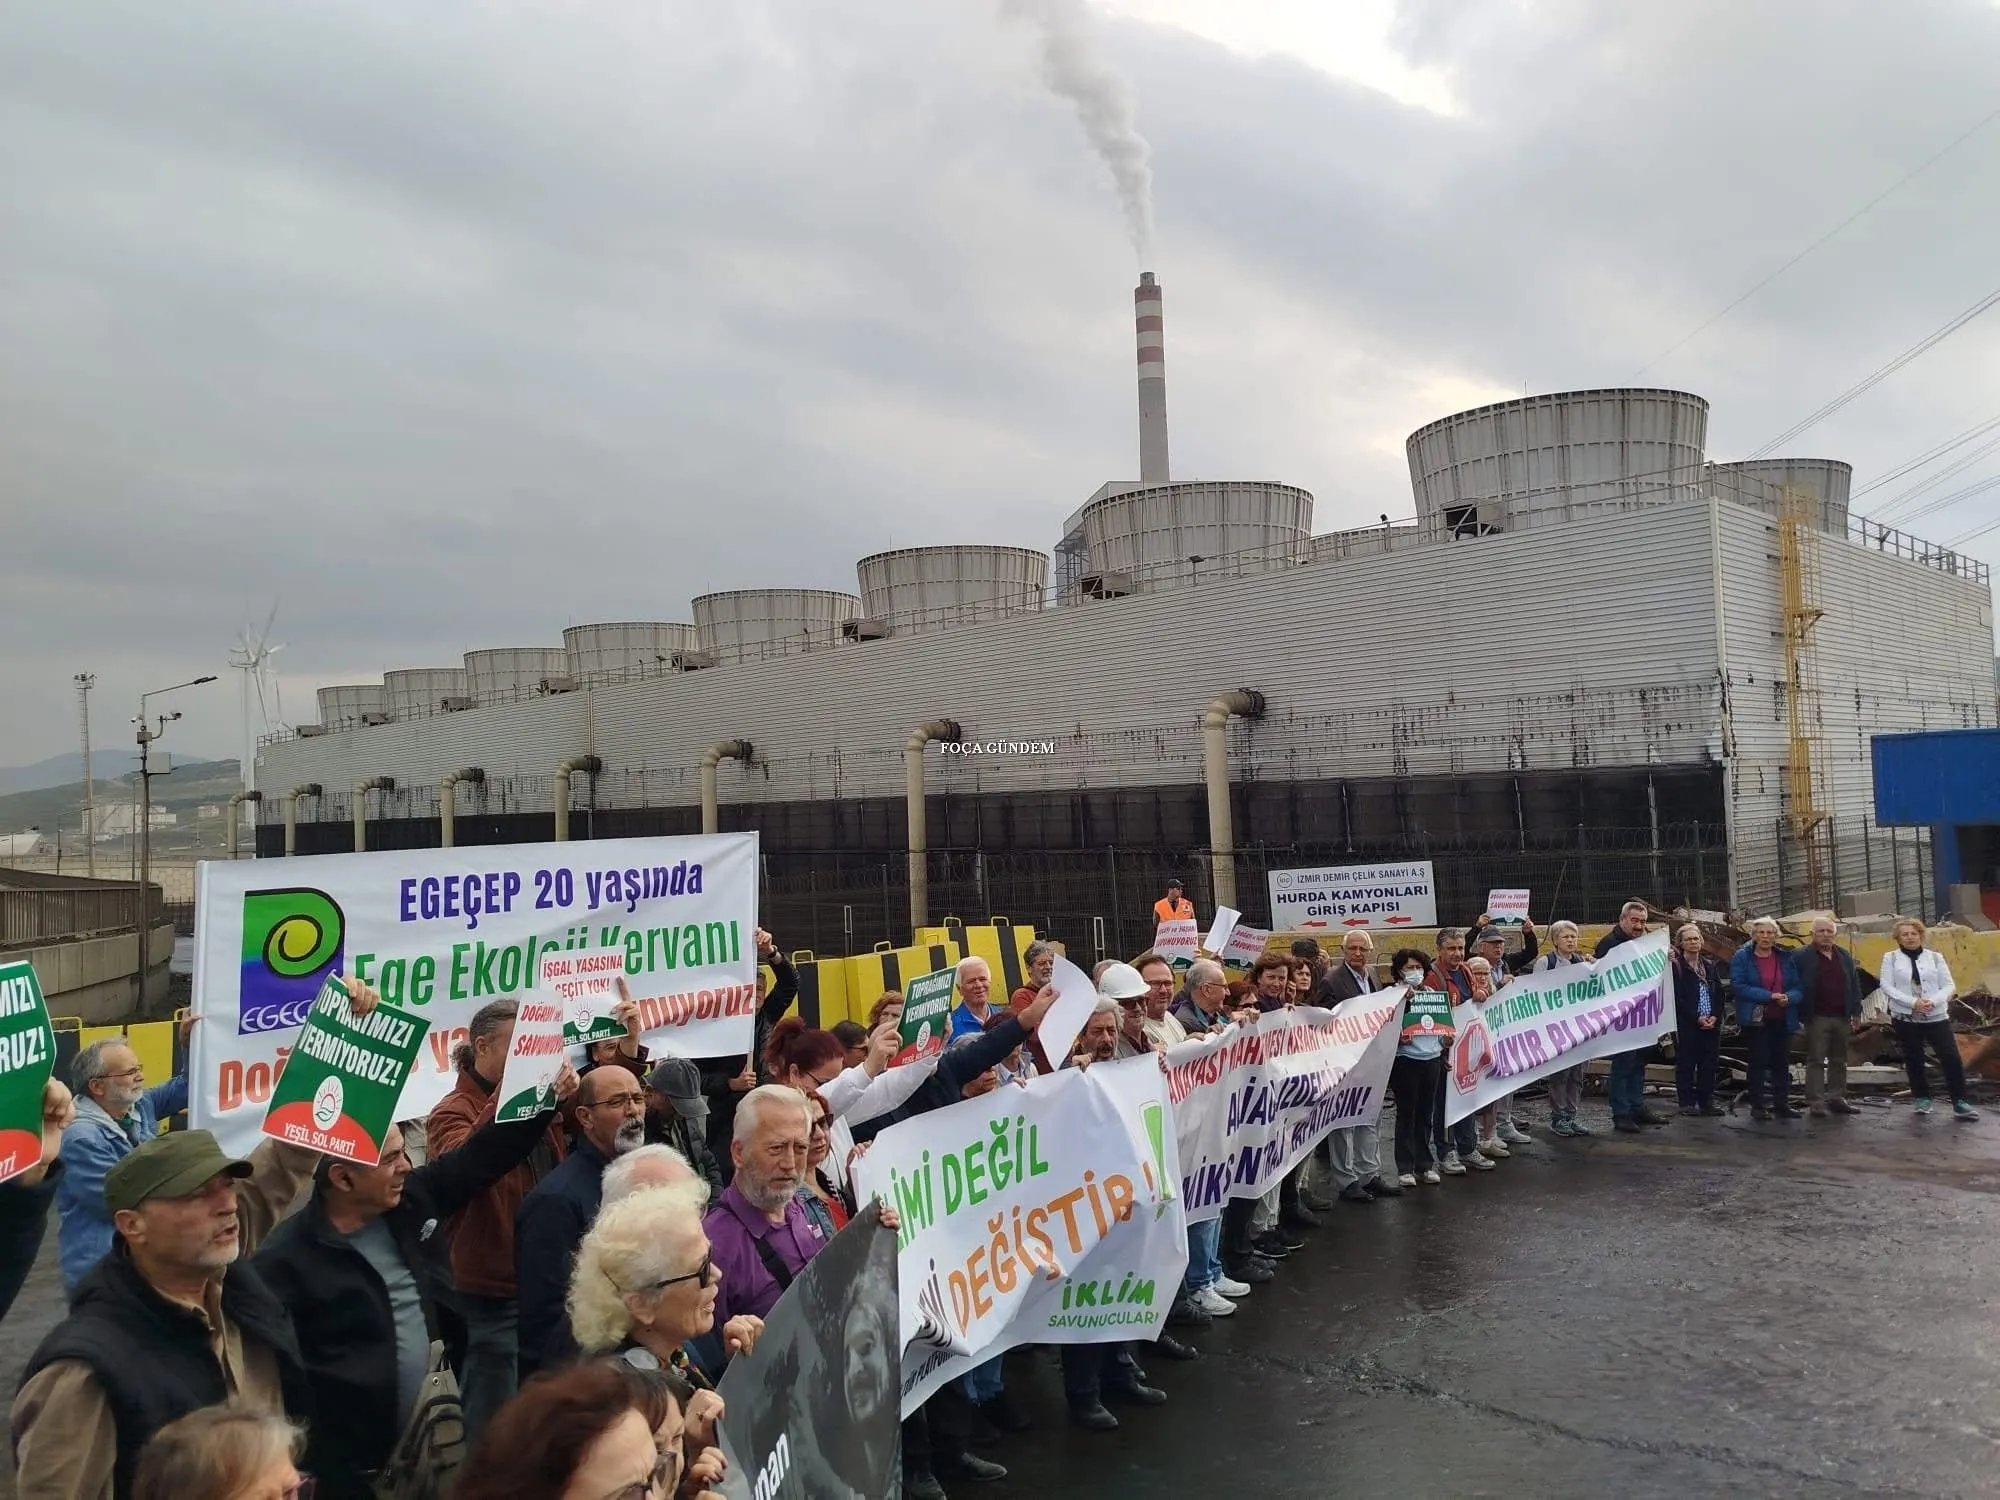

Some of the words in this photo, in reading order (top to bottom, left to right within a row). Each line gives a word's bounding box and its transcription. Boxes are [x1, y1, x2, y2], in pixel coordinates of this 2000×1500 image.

[1297, 873, 1321, 884] İZMİR
[1323, 872, 1350, 882] DEMİR
[1352, 870, 1376, 882] ÇELİK
[1378, 868, 1409, 879] SANAYİ
[400, 871, 521, 929] EGEÇEP
[535, 868, 573, 909] 20
[586, 860, 703, 913] yaşında
[1277, 891, 1327, 904] HURDA
[1332, 885, 1428, 900] KAMYONLARI
[1307, 903, 1346, 917] GİRİŞ
[1351, 901, 1400, 914] KAPISI
[543, 959, 572, 981] İŞGAL
[576, 954, 623, 975] YASASINA
[588, 977, 610, 995] YOK!
[1506, 989, 1542, 1024] TARİH
[1543, 988, 1564, 1011] ve
[1566, 974, 1606, 1004] DOĞA
[578, 1031, 591, 1043] SOL
[591, 1027, 611, 1040] PARTİ
[299, 1021, 403, 1088] VERMİYORUZ!
[283, 1122, 310, 1144] YEŞİL
[311, 1128, 330, 1149] SOL
[330, 1134, 356, 1156] PARTİ
[942, 1115, 1049, 1216] DEĞİL
[1061, 1271, 1156, 1310] İKLİM
[1048, 1310, 1160, 1329] SAVUNUCULARI
